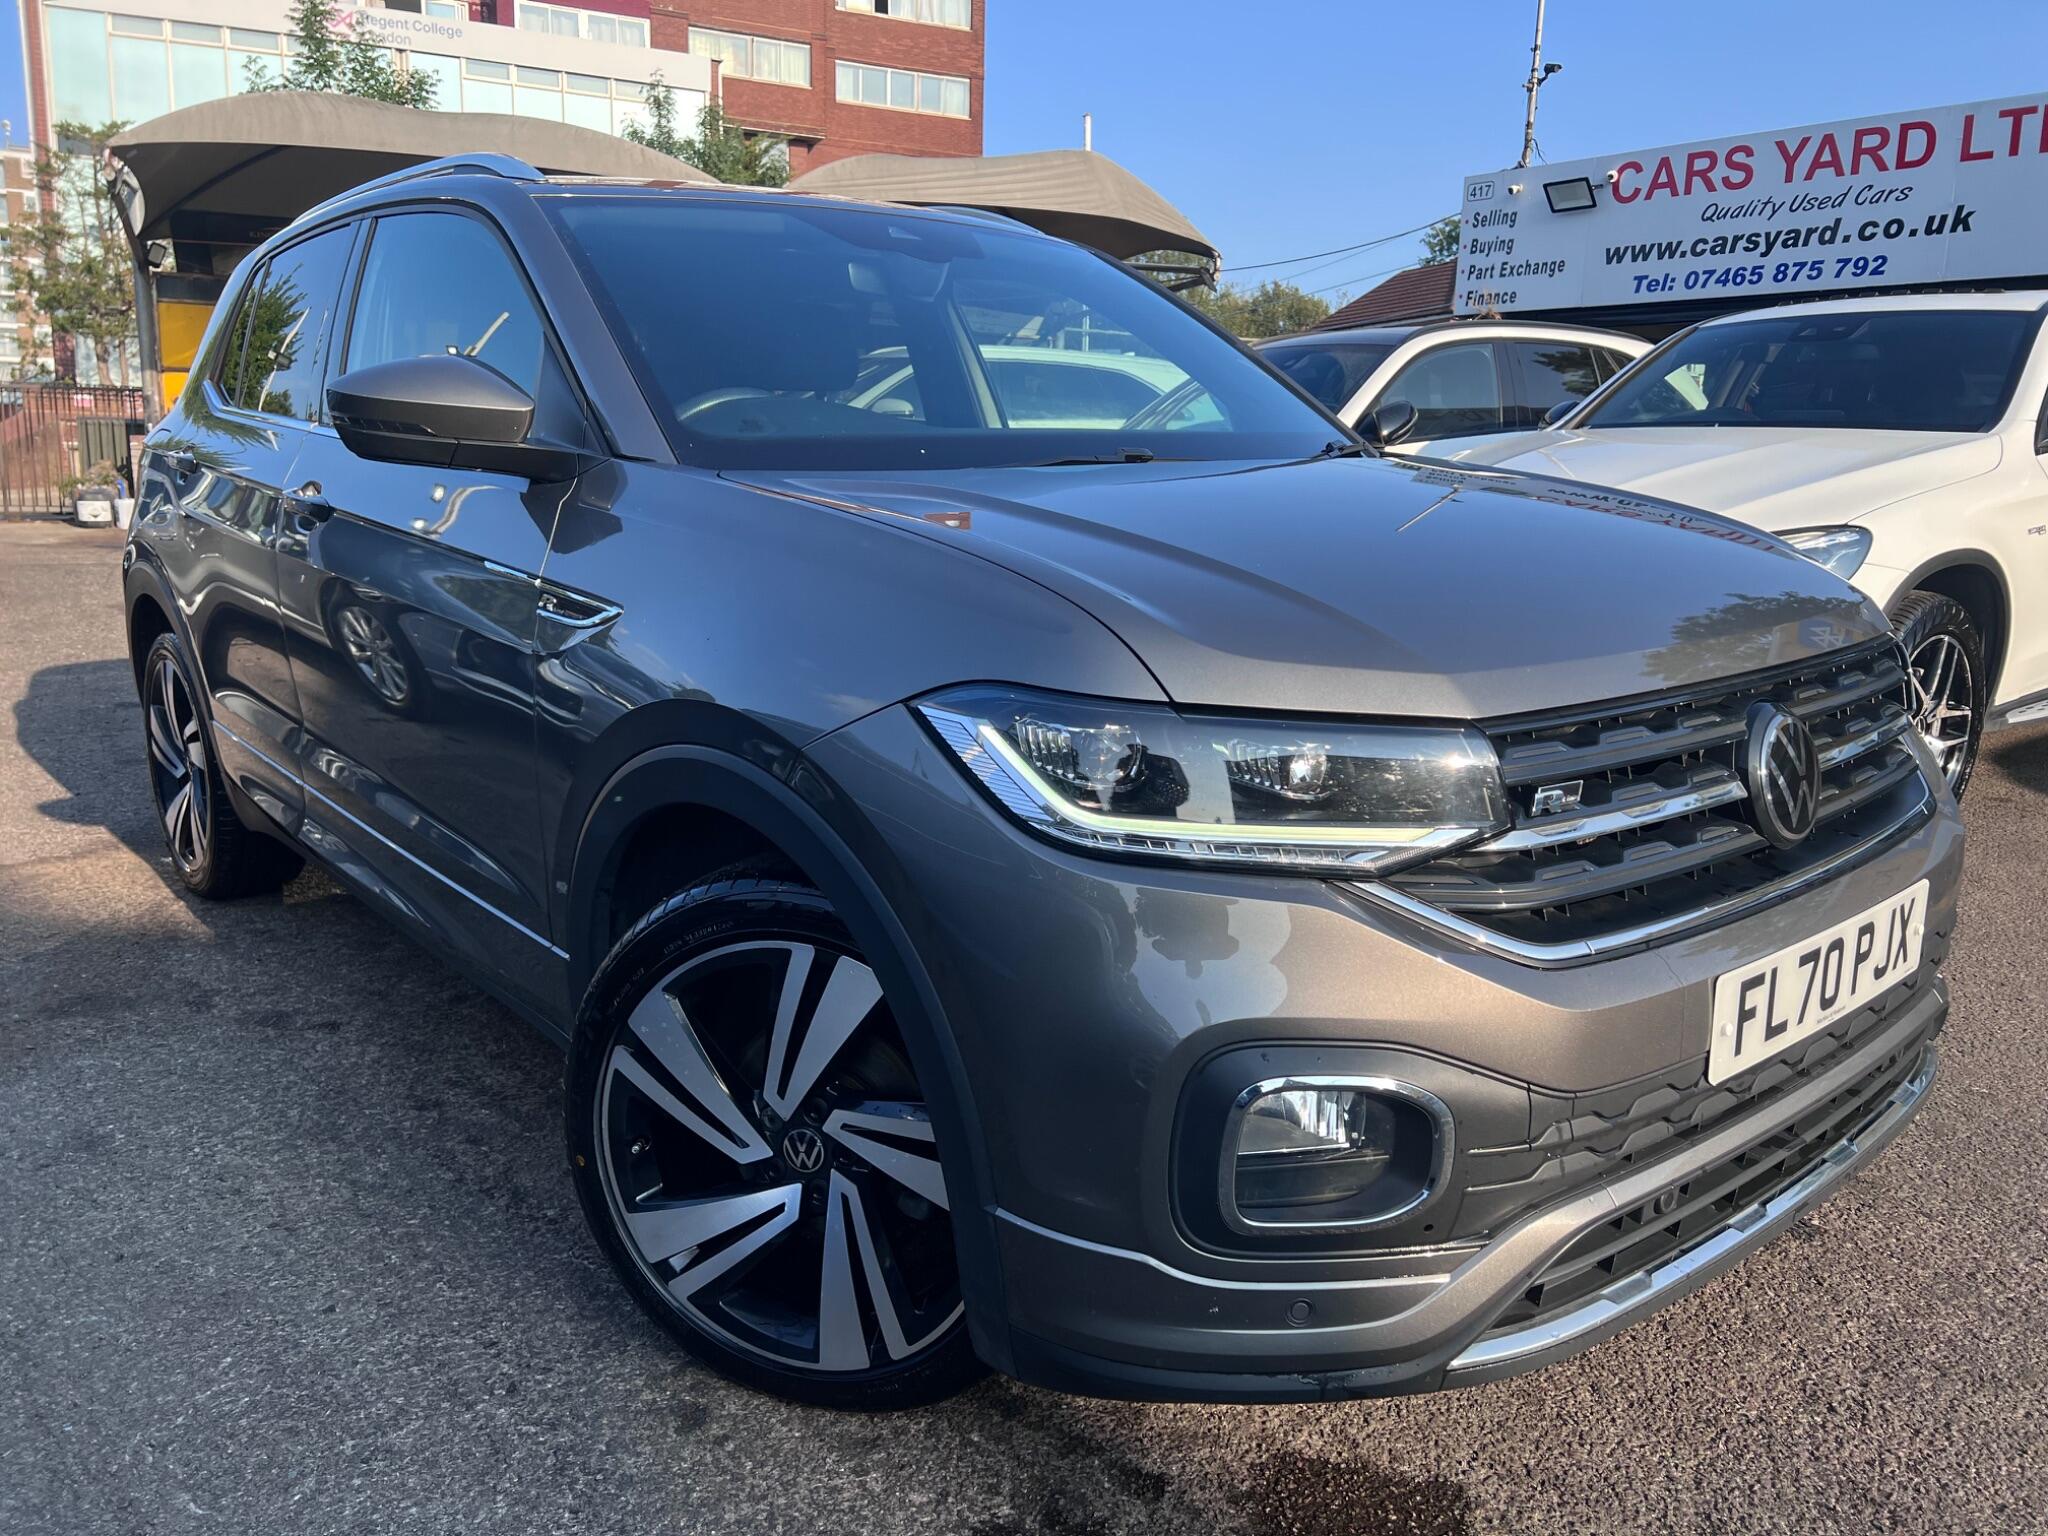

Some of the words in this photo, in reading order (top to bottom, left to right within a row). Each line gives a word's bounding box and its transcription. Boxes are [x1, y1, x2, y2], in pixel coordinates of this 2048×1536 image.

[412, 19, 464, 39] College
[1611, 144, 1755, 204] CARS
[1775, 120, 1937, 183] YARD
[1959, 104, 2048, 162] LT
[1469, 184, 1492, 199] 417
[1701, 196, 1786, 222] Quality
[1788, 185, 1853, 214] Used
[1854, 184, 1914, 206] Cars
[1472, 208, 1518, 229] Selling
[1605, 204, 1977, 265] www.carsyard.co.uk
[1470, 235, 1515, 257] Buying
[1467, 263, 1496, 280] Part
[1499, 259, 1566, 278] Exchange
[1633, 273, 1677, 294] Tel:
[1684, 264, 1765, 290] 07465
[1772, 259, 1826, 283] 875
[1834, 255, 1889, 278] 792
[1465, 290, 1518, 307] Finance
[1734, 936, 1845, 1057] FL70
[1851, 896, 1916, 996] PJX
